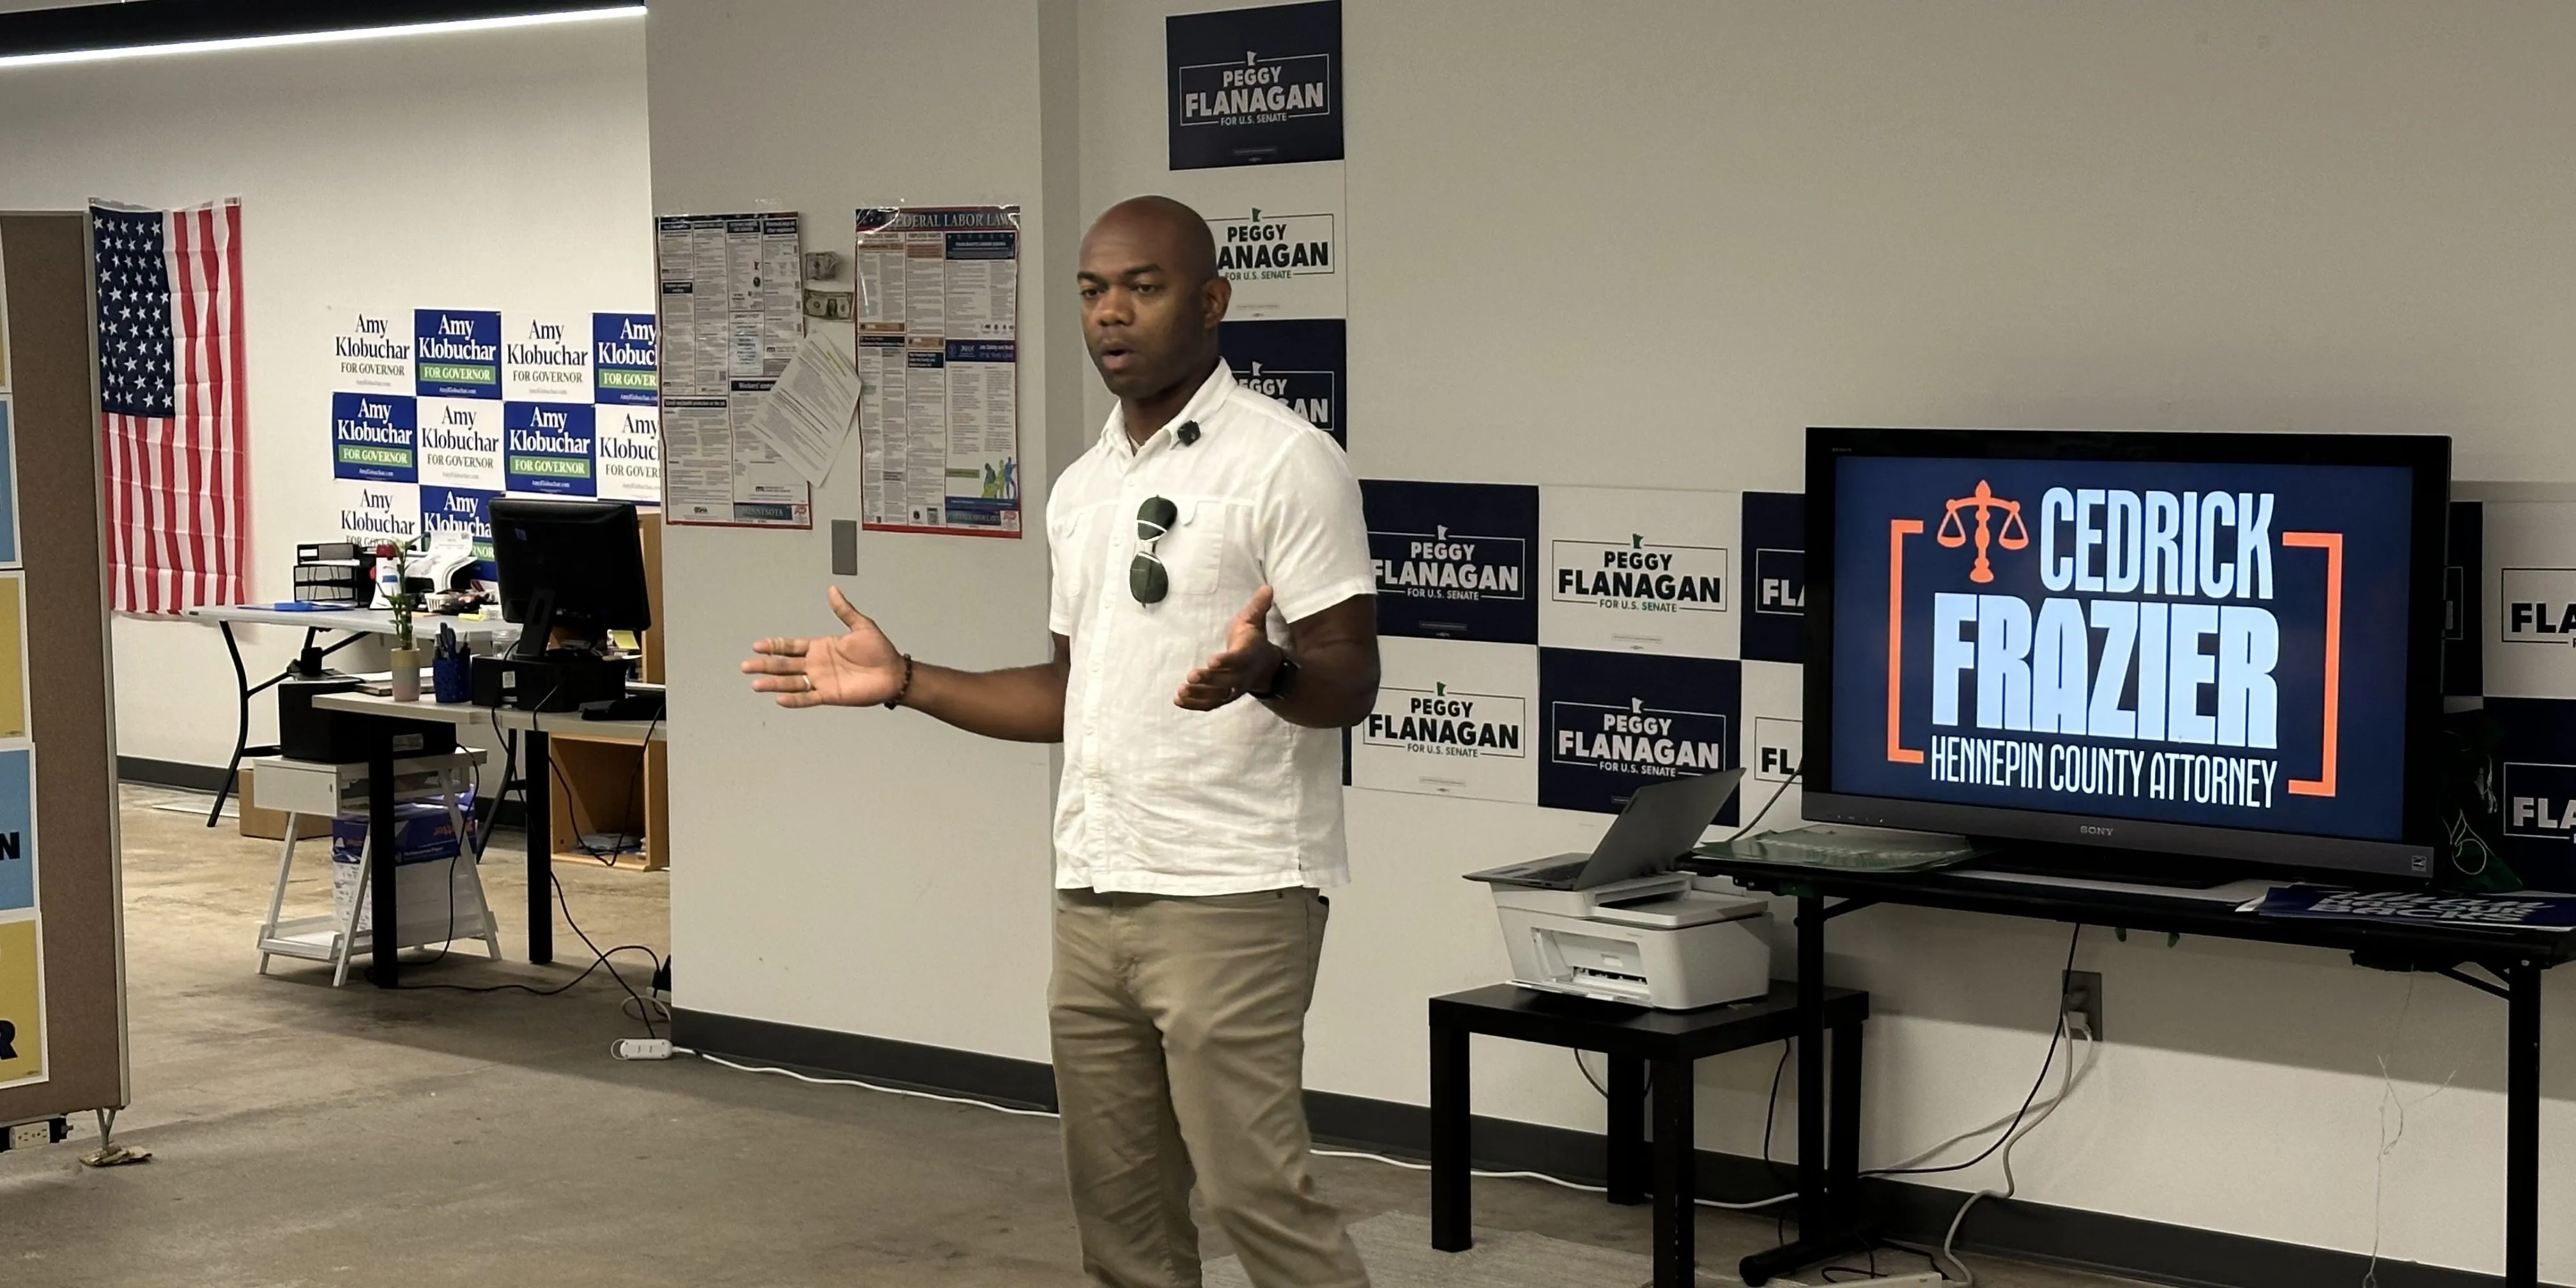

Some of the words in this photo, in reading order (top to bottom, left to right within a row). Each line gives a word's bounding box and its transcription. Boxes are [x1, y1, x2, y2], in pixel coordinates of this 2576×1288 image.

[1223, 67, 1282, 87] PEGGY
[1186, 83, 1323, 118] FLANAGAN
[1221, 118, 1236, 126] FOR
[1239, 116, 1255, 125] U.S.
[1257, 113, 1287, 123] SENATE
[944, 213, 983, 226] LABOR
[1227, 224, 1287, 243] PEGGY
[1218, 242, 1328, 269] ANAGAN
[1244, 272, 1259, 280] U.S.
[1261, 270, 1291, 279] SENATE
[355, 314, 388, 339] Amy
[438, 314, 473, 340] Amy
[529, 319, 564, 344] Amy
[620, 318, 656, 345] Amy
[335, 336, 410, 359] Klobuchar
[418, 337, 496, 360] Klobuchar
[507, 344, 588, 365] Klobuchar
[598, 342, 657, 365] Klobuc
[341, 362, 357, 374] FOR
[359, 363, 404, 376] GOVERNOR
[424, 367, 441, 379] FOR
[442, 367, 490, 381] GOVERNOR
[513, 370, 530, 381] FOR
[532, 371, 583, 383] GOVERNOR
[604, 373, 622, 385] FOR
[624, 374, 657, 386] GOVER
[358, 397, 392, 424] Amy
[442, 405, 477, 430] Amy
[530, 406, 567, 433] Amy
[338, 419, 412, 444] Klobuchar
[622, 413, 657, 439] Amy
[422, 428, 499, 452] Klobuchar
[510, 429, 590, 454] Klobuchar
[600, 437, 659, 460] Klobuc
[344, 448, 360, 459] FOR
[362, 450, 407, 464] GOVERNOR
[427, 454, 445, 465] FOR
[446, 456, 493, 468] GOVERNOR
[515, 459, 533, 471] FOR
[535, 461, 585, 474] GOVERNOR
[606, 464, 624, 475] FOR
[626, 465, 660, 478] GOVER
[360, 489, 394, 514] Amy
[444, 491, 479, 518] Amy
[341, 510, 415, 535] Klobuchar
[424, 512, 491, 537] Klobucha
[1411, 542, 1475, 561] PEGGY
[2039, 487, 2274, 601] CEDRICK
[1604, 551, 1673, 571] PEGGY
[1370, 559, 1517, 591] FLANAGAN
[1559, 569, 1721, 603] FLANAGAN
[1407, 588, 1425, 597] FOR
[1427, 590, 1445, 599] U.S.
[1446, 590, 1479, 601] SENATE
[1599, 599, 1618, 608] FOR
[1621, 601, 1639, 610] U.S.
[1642, 602, 1676, 613] SENATE
[1932, 592, 2281, 749] FRAZIER
[1411, 698, 1473, 717] PEGGY
[1369, 714, 1518, 749] FLANAGAN
[1604, 714, 1672, 736] PEGGY
[1407, 744, 1425, 753] FOR
[1427, 745, 1443, 755] U.S.
[1446, 747, 1478, 757] SENATE
[1559, 730, 1719, 769] FLANAGAN
[1599, 762, 1618, 770] FOR
[1621, 763, 1638, 773] U.S.
[1641, 765, 1676, 777] SENATE
[1930, 735, 2043, 790] HENNEPIN
[2050, 745, 2145, 797] COUNTY
[2149, 752, 2278, 809] ATTORNEY
[2080, 825, 2114, 836] SONY
[2307, 903, 2526, 922] BACKS
